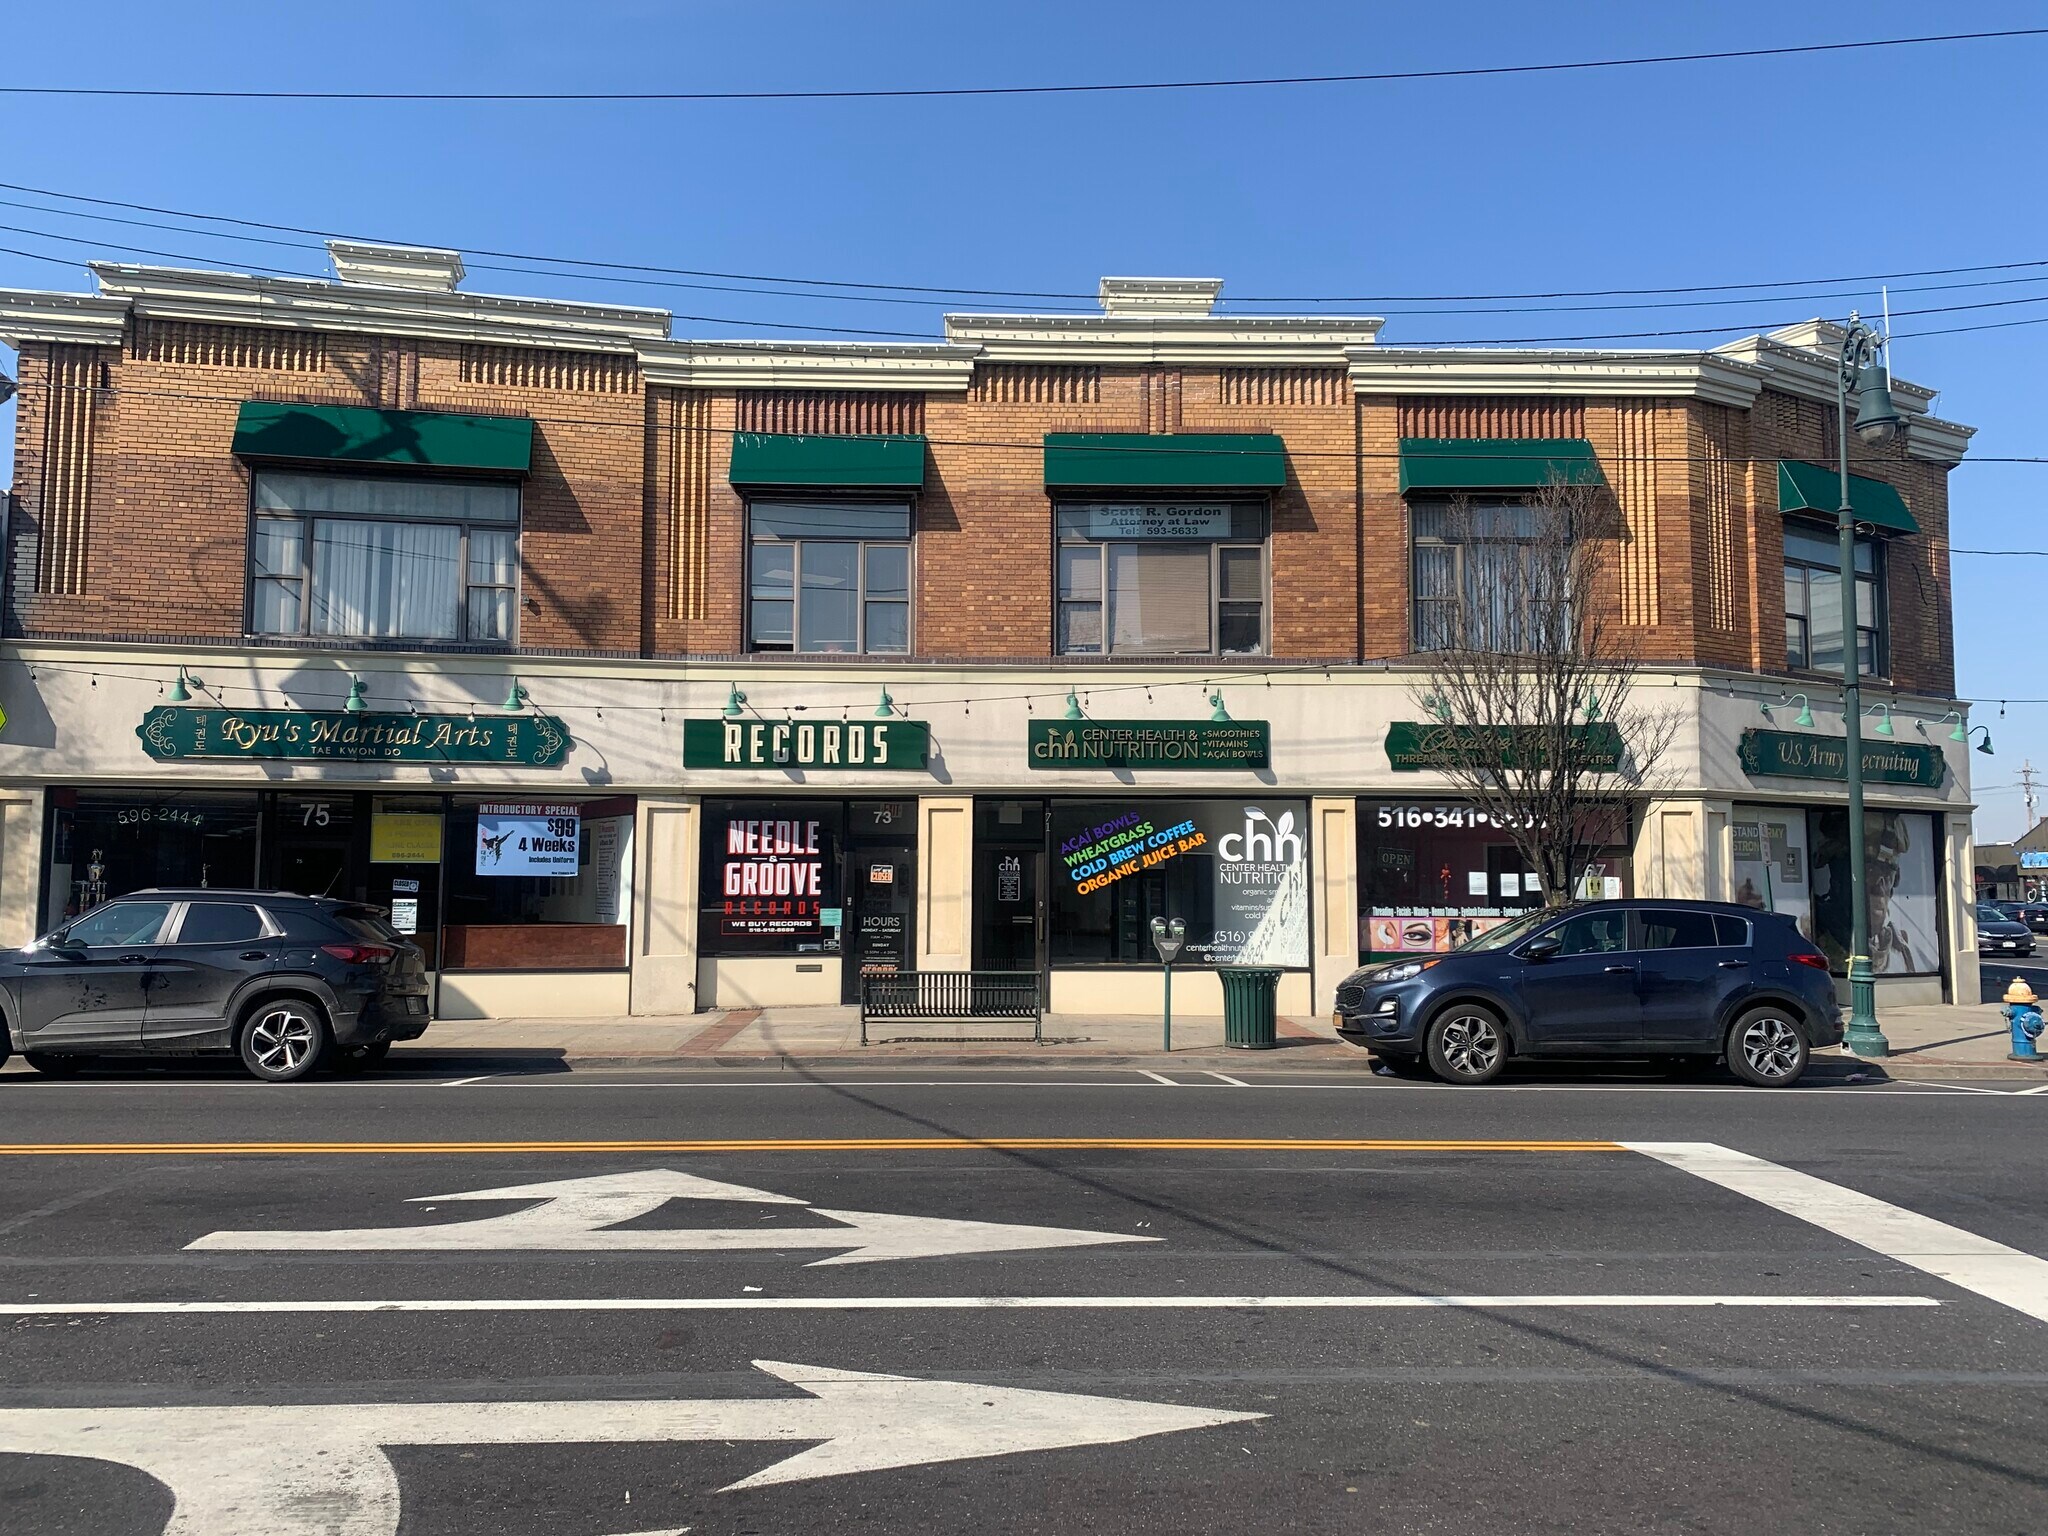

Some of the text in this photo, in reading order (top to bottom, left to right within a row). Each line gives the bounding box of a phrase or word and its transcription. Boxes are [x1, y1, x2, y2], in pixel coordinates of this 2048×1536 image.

[1100, 507, 1222, 516] Scott R. Gordon
[1110, 518, 1164, 527] Attorney
[1119, 527, 1199, 535] Tel: 593-5633
[222, 717, 493, 749] Ryu's Martial Arts
[1082, 729, 1199, 741] CENTER HEALTH &
[724, 724, 888, 763] RECORDS
[1083, 741, 1199, 759] NUTRITION
[311, 746, 401, 756] TAE KWON DO
[1232, 750, 1264, 758] BOWLS
[1805, 745, 1845, 774] Army
[1860, 751, 1920, 779] ecruiting
[300, 804, 330, 826] 75
[480, 804, 579, 815] INTRODUCTORY SPECIAL
[118, 808, 203, 826] 596-2444
[873, 811, 892, 824] 73
[548, 818, 576, 837] $99
[1093, 811, 1140, 840] BOWLS
[1733, 826, 1784, 838] STAND RMY
[727, 820, 820, 855] NEEDLE
[518, 837, 575, 852] 4 Weeks
[1063, 821, 1154, 868] WHEATGRASS
[1071, 819, 1196, 881] COLD BREW COFFEE
[1733, 840, 1760, 852] STRON
[1077, 832, 1208, 895] ORGANIC JUICE BAR
[1382, 853, 1411, 865] OPEN
[1220, 863, 1255, 871] CENTER
[1584, 863, 1606, 877] 67
[724, 862, 822, 896] GROOVE
[1242, 888, 1267, 896] organic
[724, 901, 820, 915] RECORDS
[1372, 906, 1394, 917] Threading
[1396, 906, 1412, 916] Facials
[1413, 906, 1429, 917] Waxing
[1445, 906, 1459, 916] Tattoo
[1461, 906, 1477, 917] Eyelash
[1477, 906, 1500, 916] Extensions
[863, 916, 900, 926] HOURS
[1214, 931, 1246, 943] (516)
